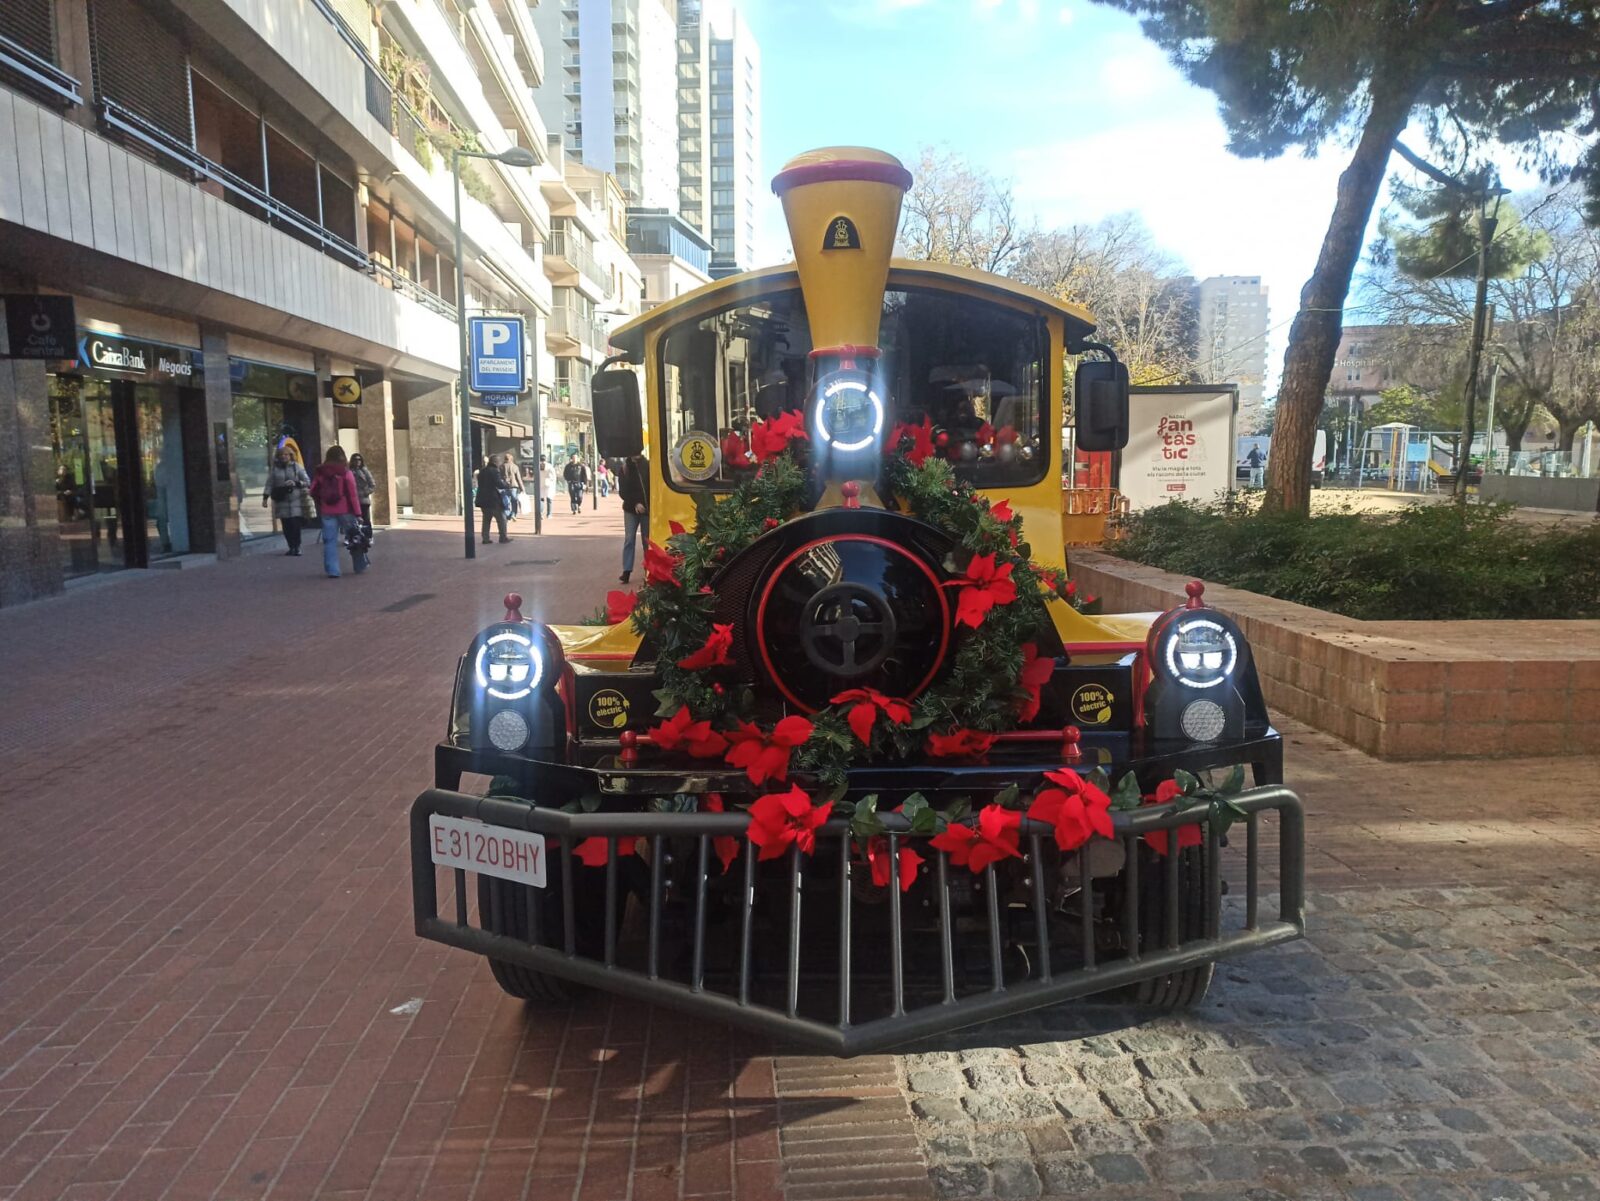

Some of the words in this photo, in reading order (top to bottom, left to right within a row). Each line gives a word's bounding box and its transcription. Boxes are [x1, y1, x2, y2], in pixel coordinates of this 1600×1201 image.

[482, 323, 511, 355] P
[92, 341, 146, 369] CaixaBank
[159, 357, 192, 377] Negocis
[1157, 416, 1193, 436] fan
[597, 697, 620, 706] 100%
[1080, 691, 1104, 702] 100%
